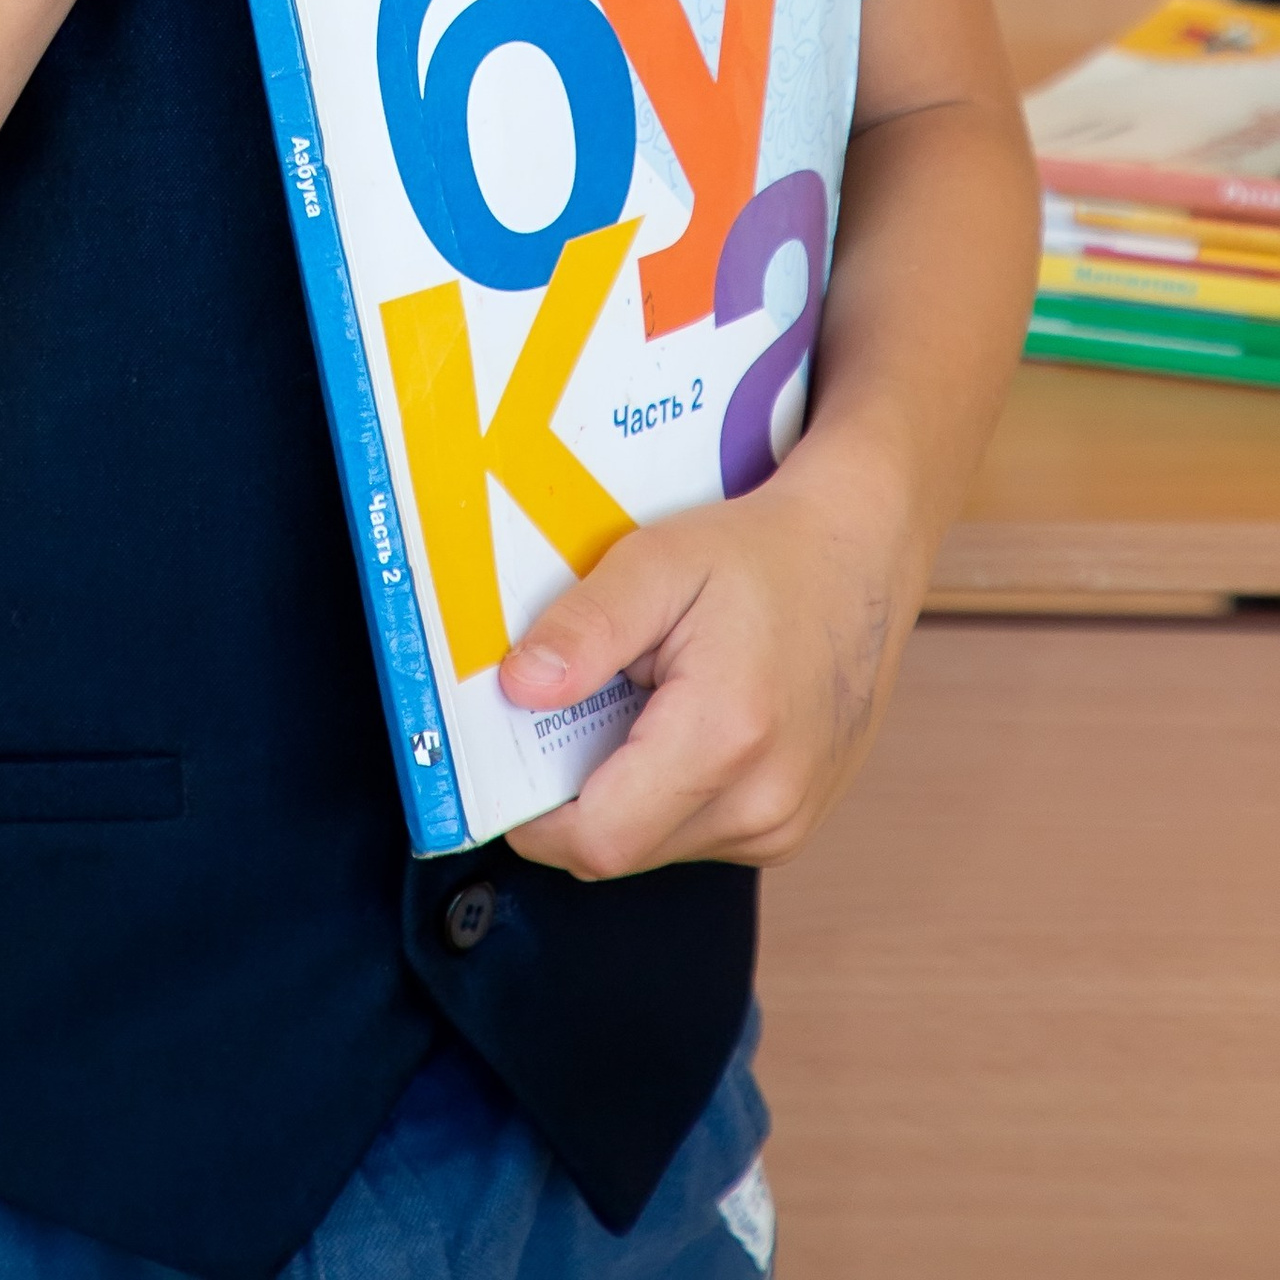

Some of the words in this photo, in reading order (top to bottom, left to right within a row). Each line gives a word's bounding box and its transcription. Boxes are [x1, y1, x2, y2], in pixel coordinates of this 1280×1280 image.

[291, 136, 321, 219] Азбука
[613, 395, 683, 438] Часть
[691, 378, 703, 413] 2
[368, 493, 392, 564] Часть
[382, 568, 402, 585] 2
[534, 678, 634, 739] ПРОСВЕЩЕНИЕ
